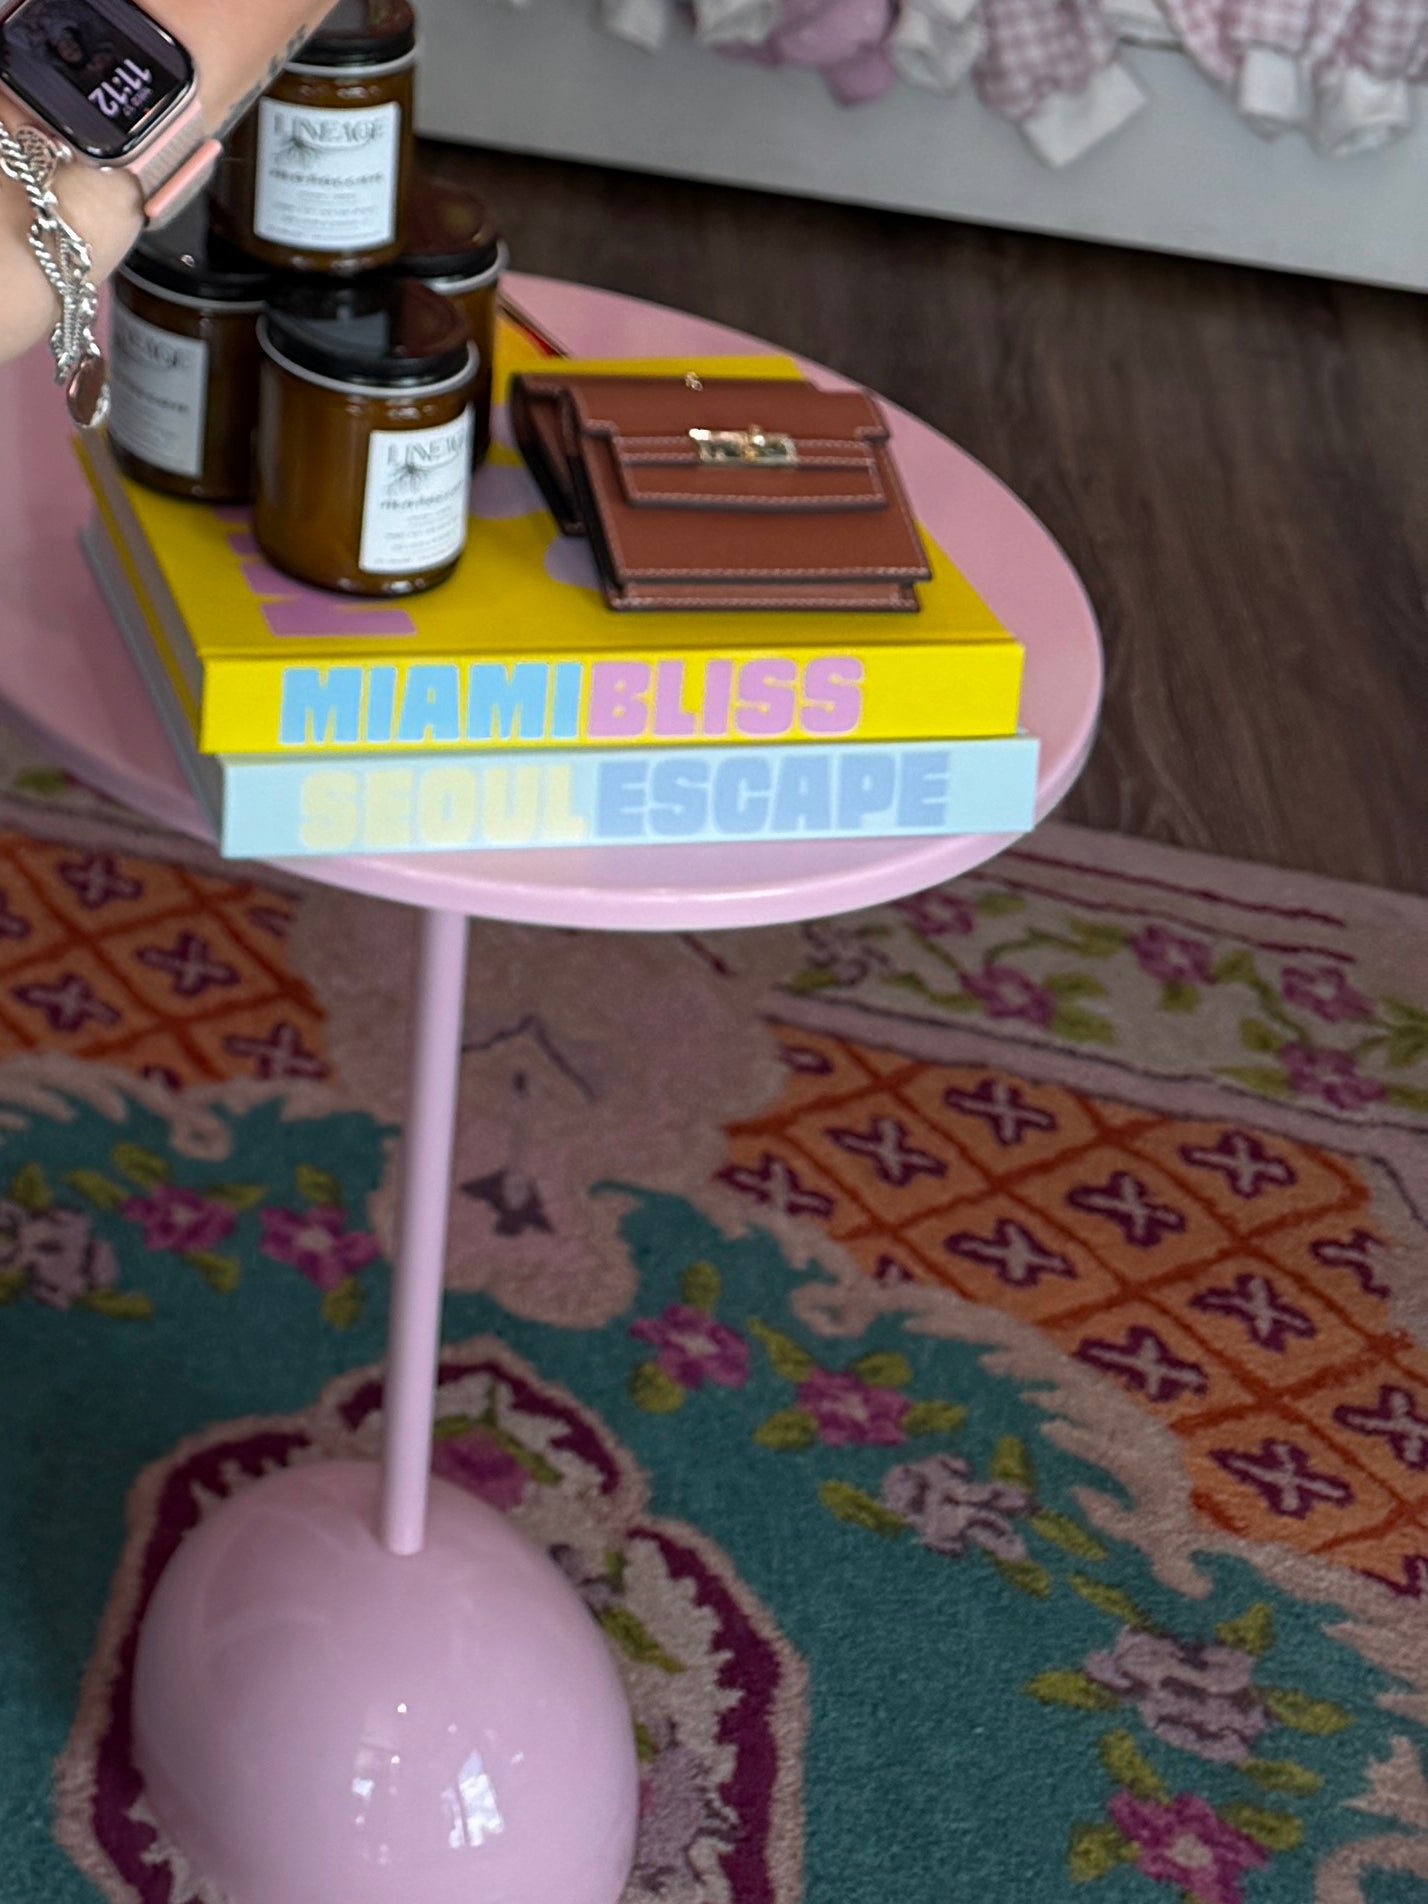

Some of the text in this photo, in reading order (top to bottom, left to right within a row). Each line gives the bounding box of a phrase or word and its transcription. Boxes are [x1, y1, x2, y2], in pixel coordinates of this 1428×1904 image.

[87, 58, 153, 118] 11:12
[272, 110, 387, 144] LINEAGE
[278, 656, 864, 745] MIAMI BLISS
[300, 751, 951, 850] SEOUL ESCAPE
